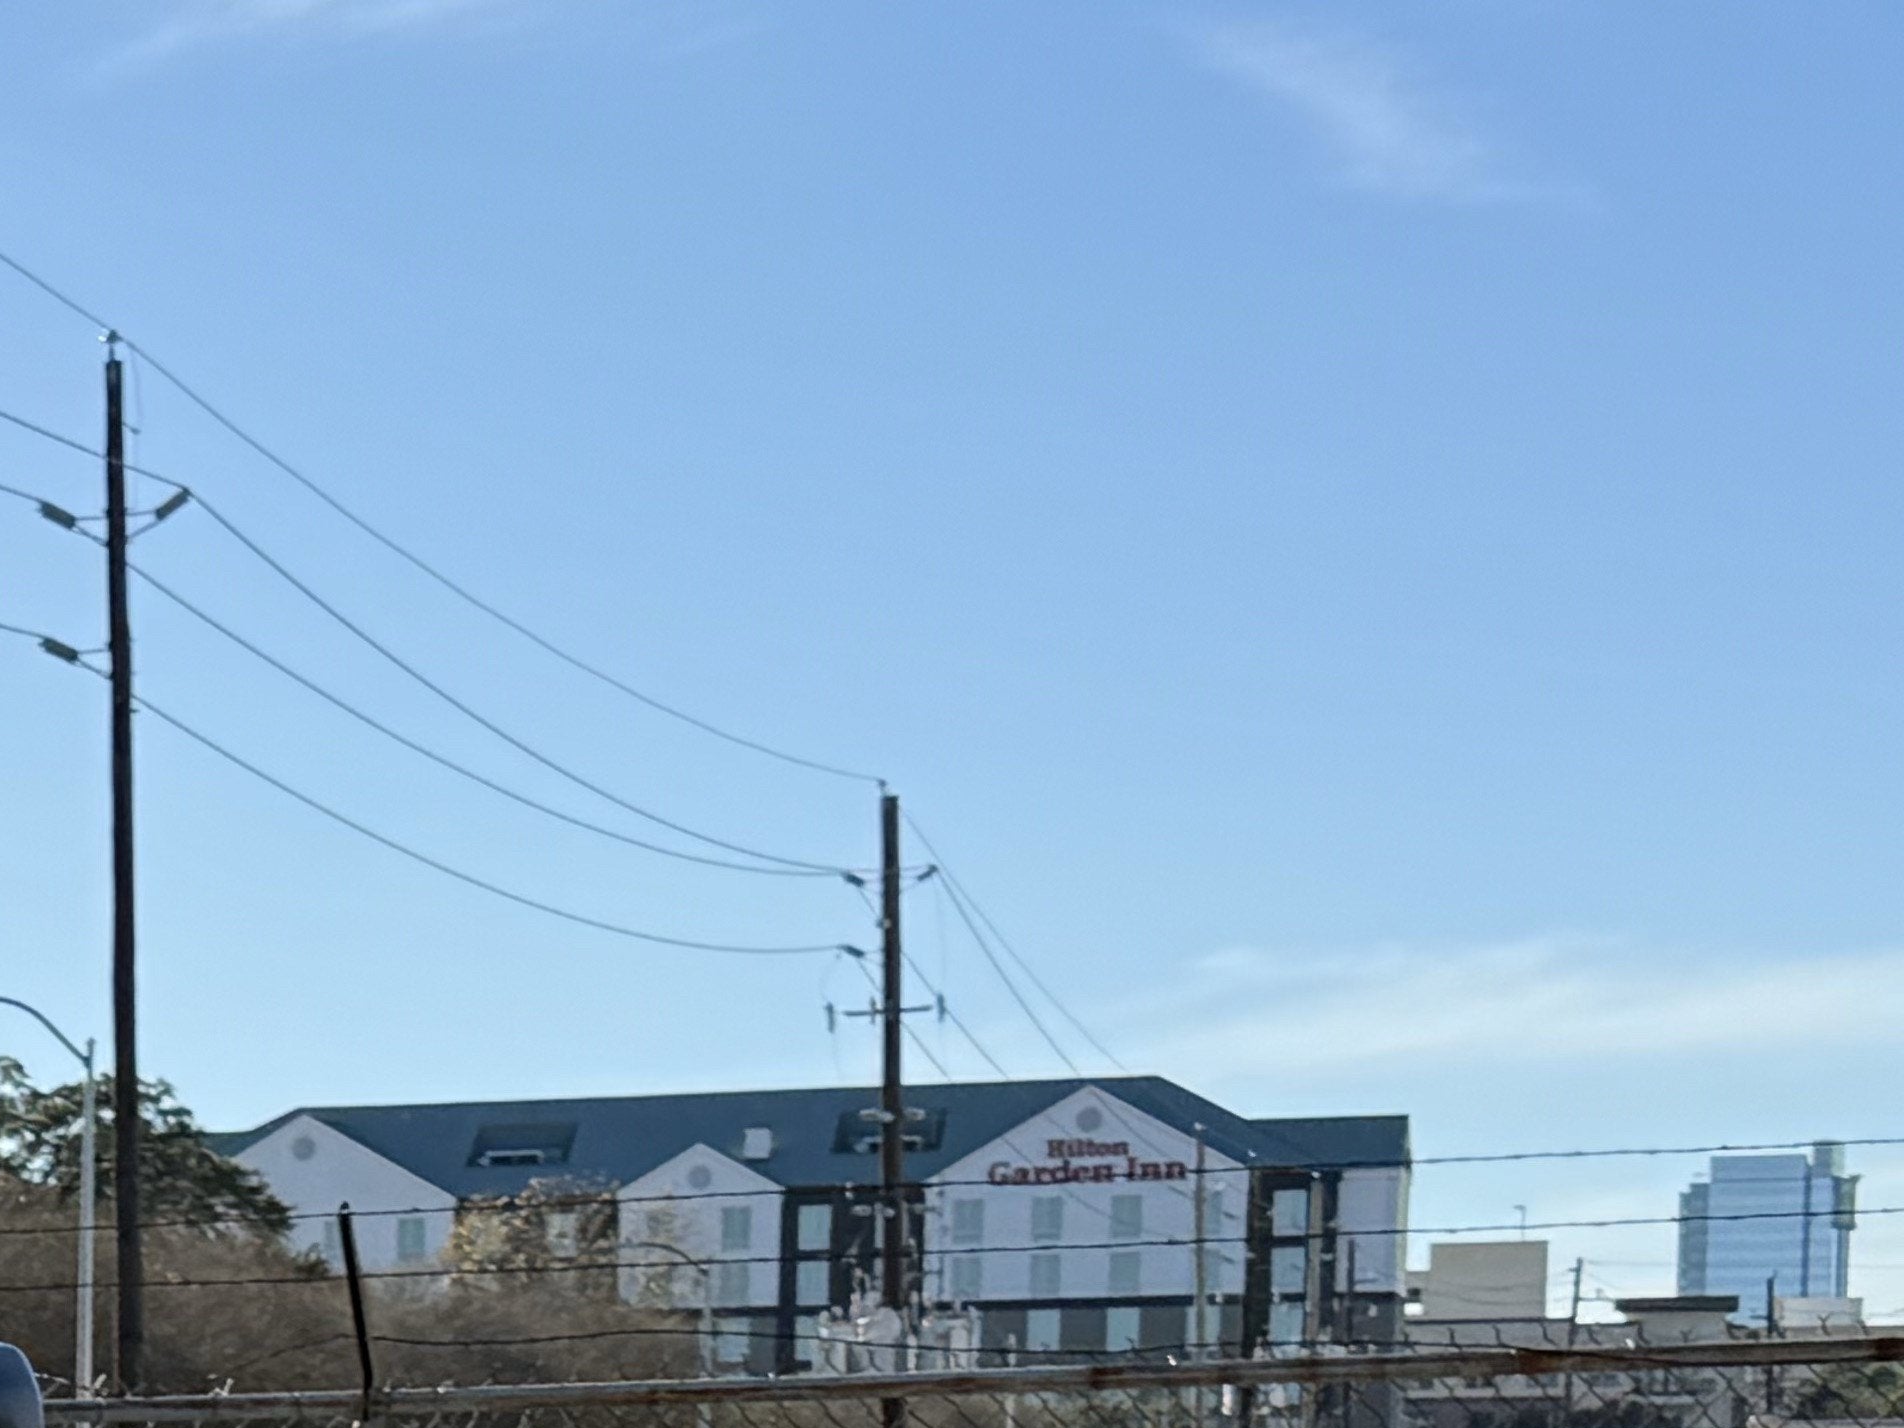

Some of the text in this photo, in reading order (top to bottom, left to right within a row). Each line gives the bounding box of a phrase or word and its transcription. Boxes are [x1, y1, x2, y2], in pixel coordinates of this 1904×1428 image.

[1047, 1139, 1129, 1158] Hilton
[989, 1157, 1186, 1184] Garden Inn
